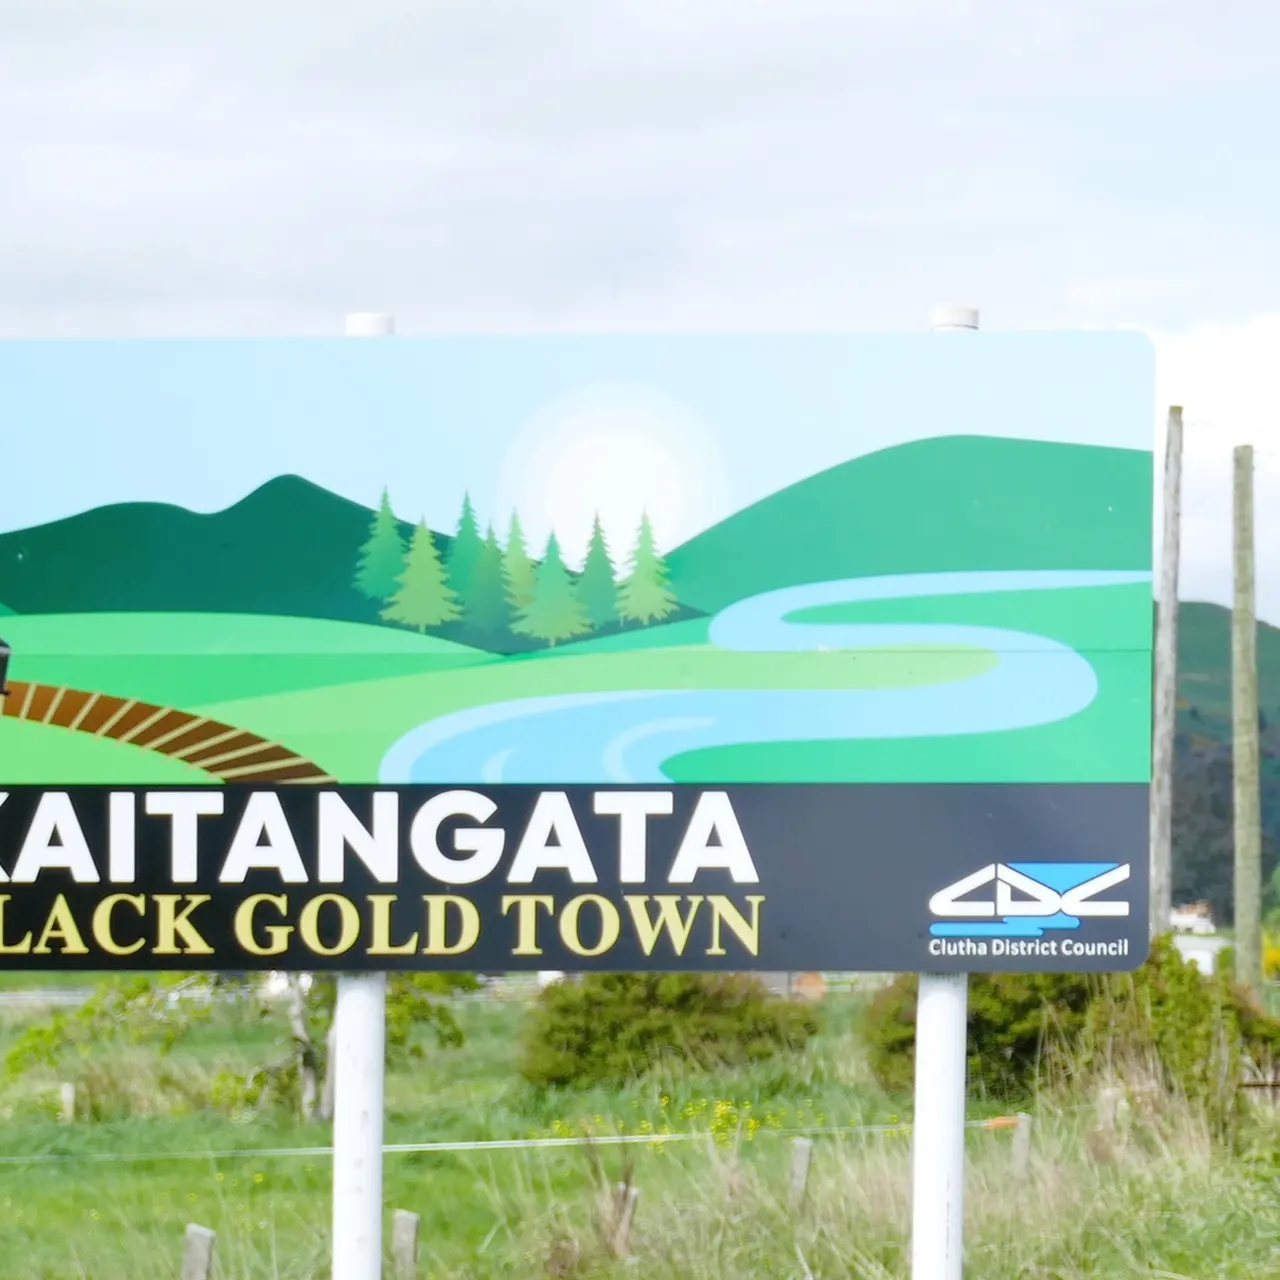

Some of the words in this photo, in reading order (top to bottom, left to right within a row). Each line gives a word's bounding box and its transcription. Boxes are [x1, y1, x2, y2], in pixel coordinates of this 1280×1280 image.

[233, 892, 481, 956] GOLD
[500, 893, 766, 958] TOWN
[928, 938, 988, 956] Clutha
[991, 938, 1058, 956] District
[1060, 938, 1129, 956] Council
